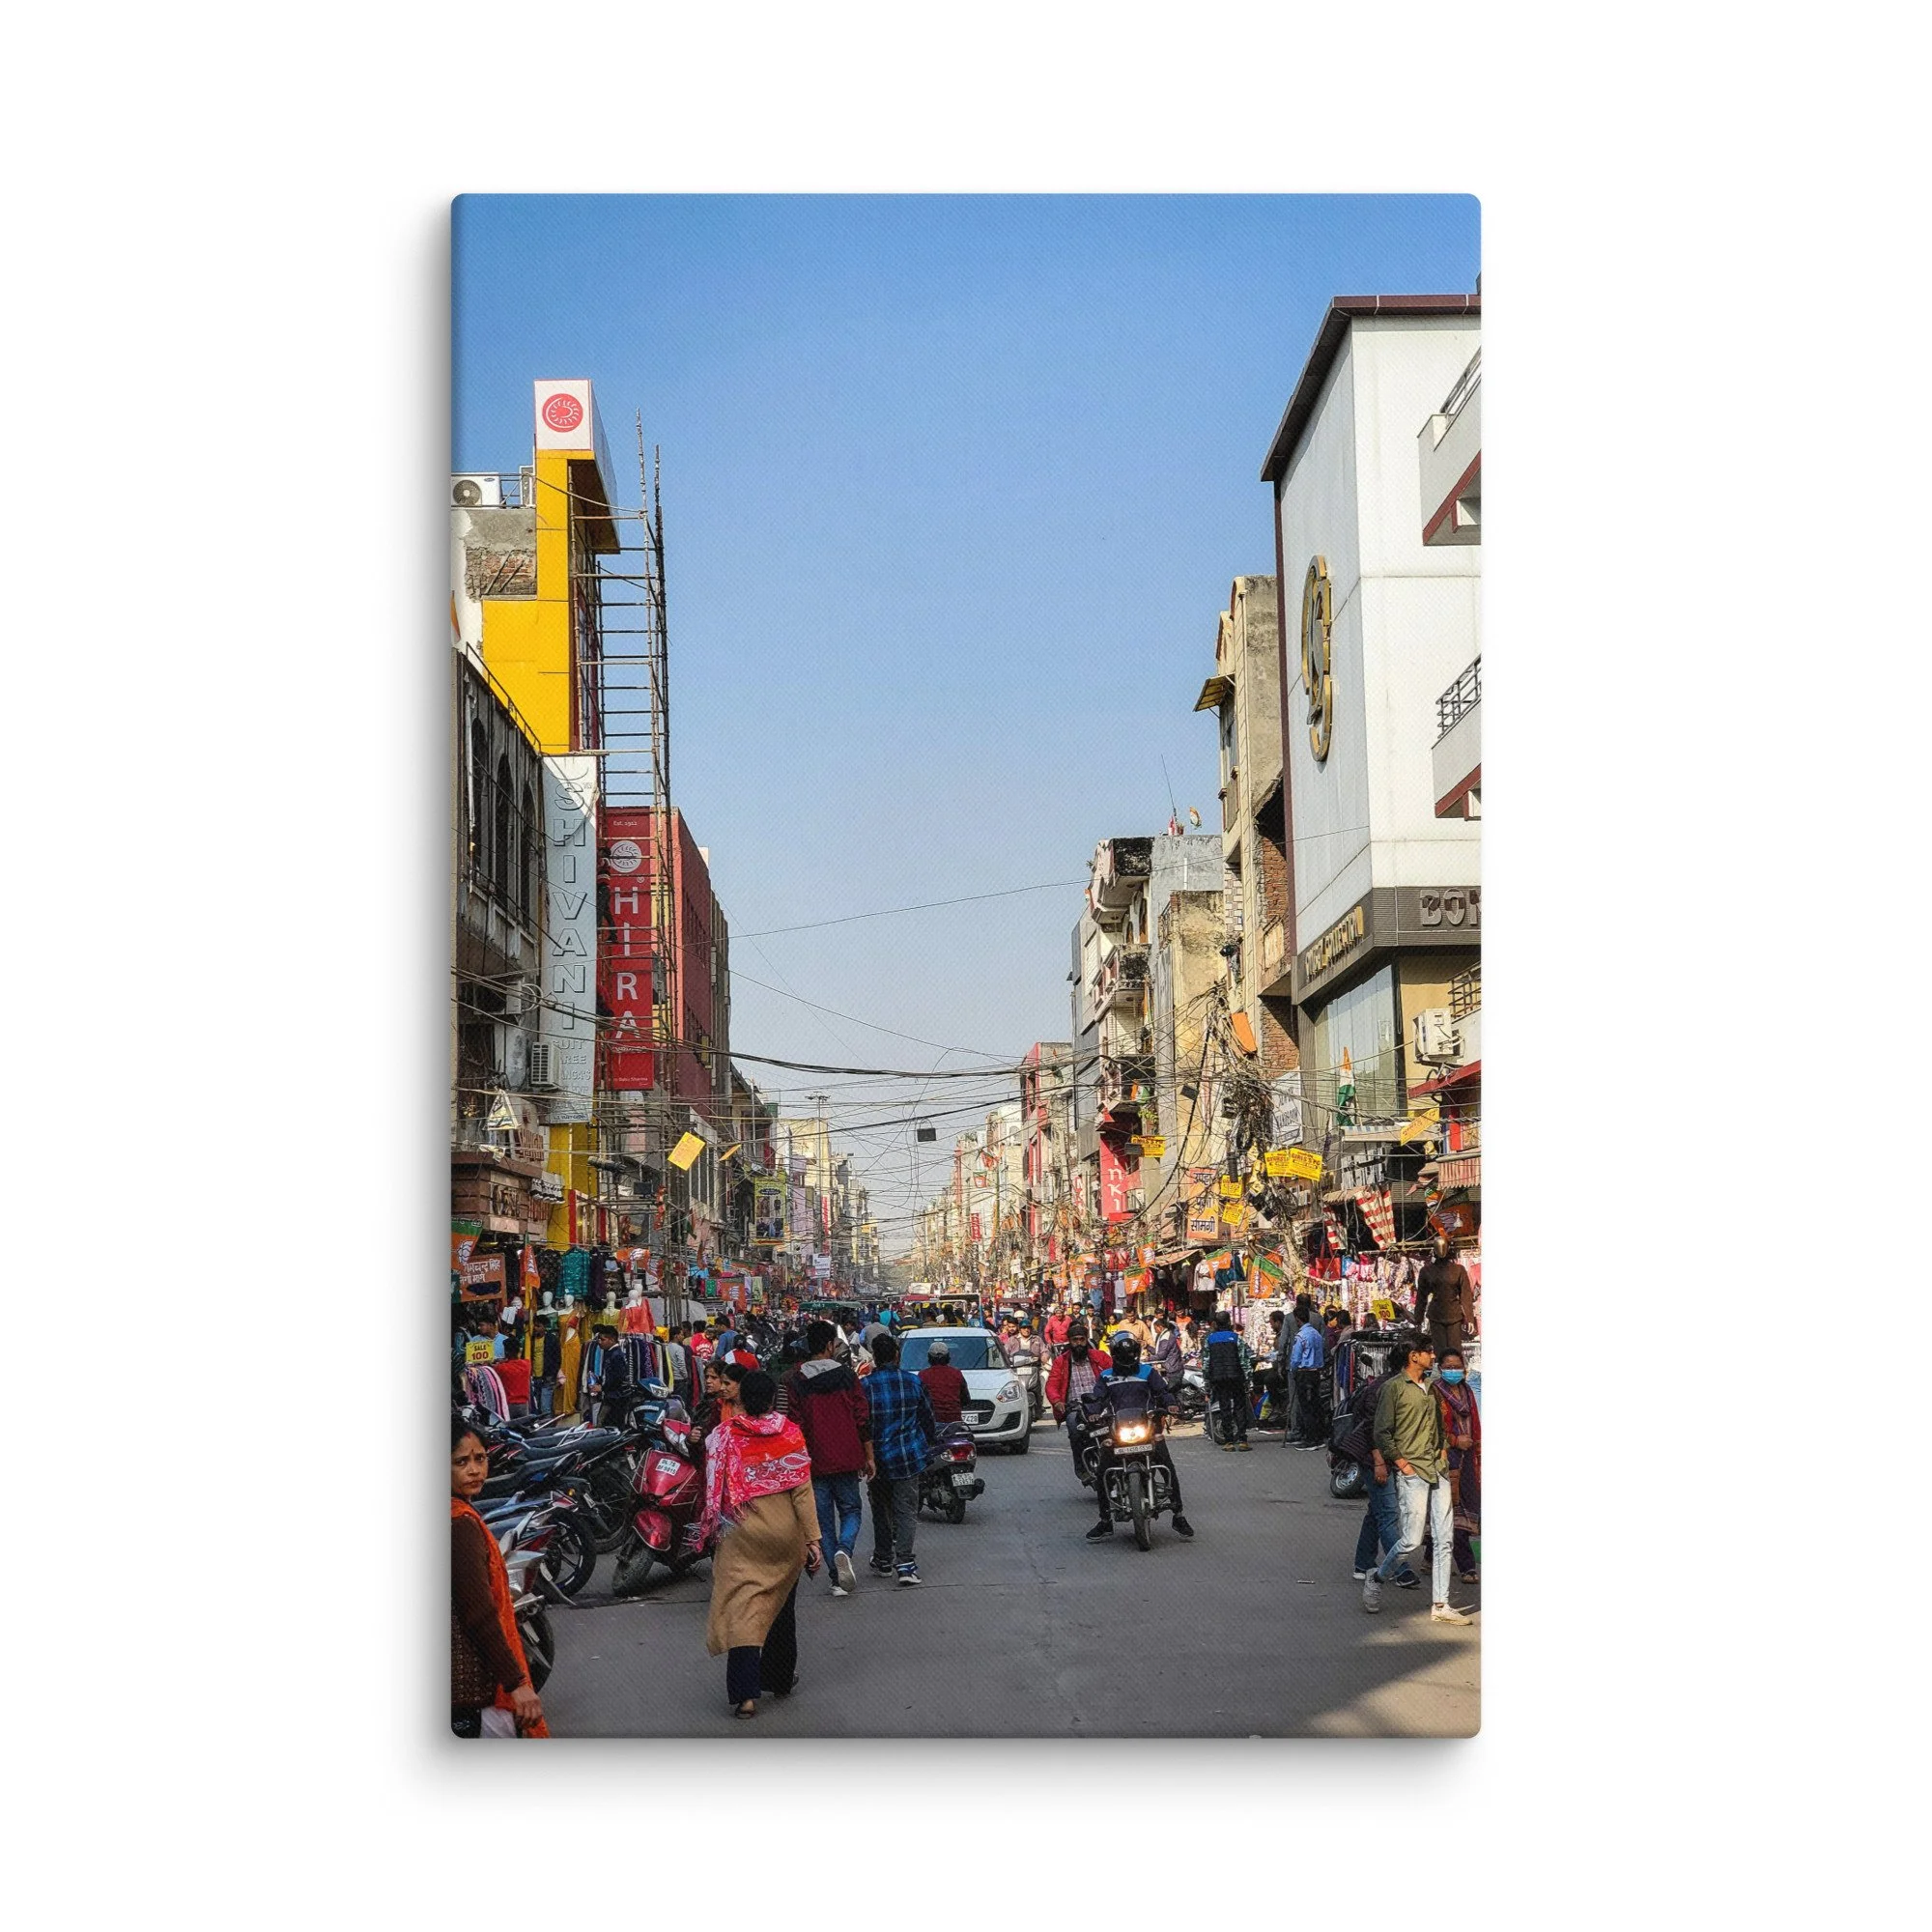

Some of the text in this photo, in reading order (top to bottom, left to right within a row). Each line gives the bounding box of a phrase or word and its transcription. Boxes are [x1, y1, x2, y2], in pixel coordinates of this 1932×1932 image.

[554, 781, 587, 1031] SHIVANI
[614, 886, 640, 1039] HIRA
[471, 1350, 489, 1360] 100
[1378, 1310, 1391, 1319] 100
